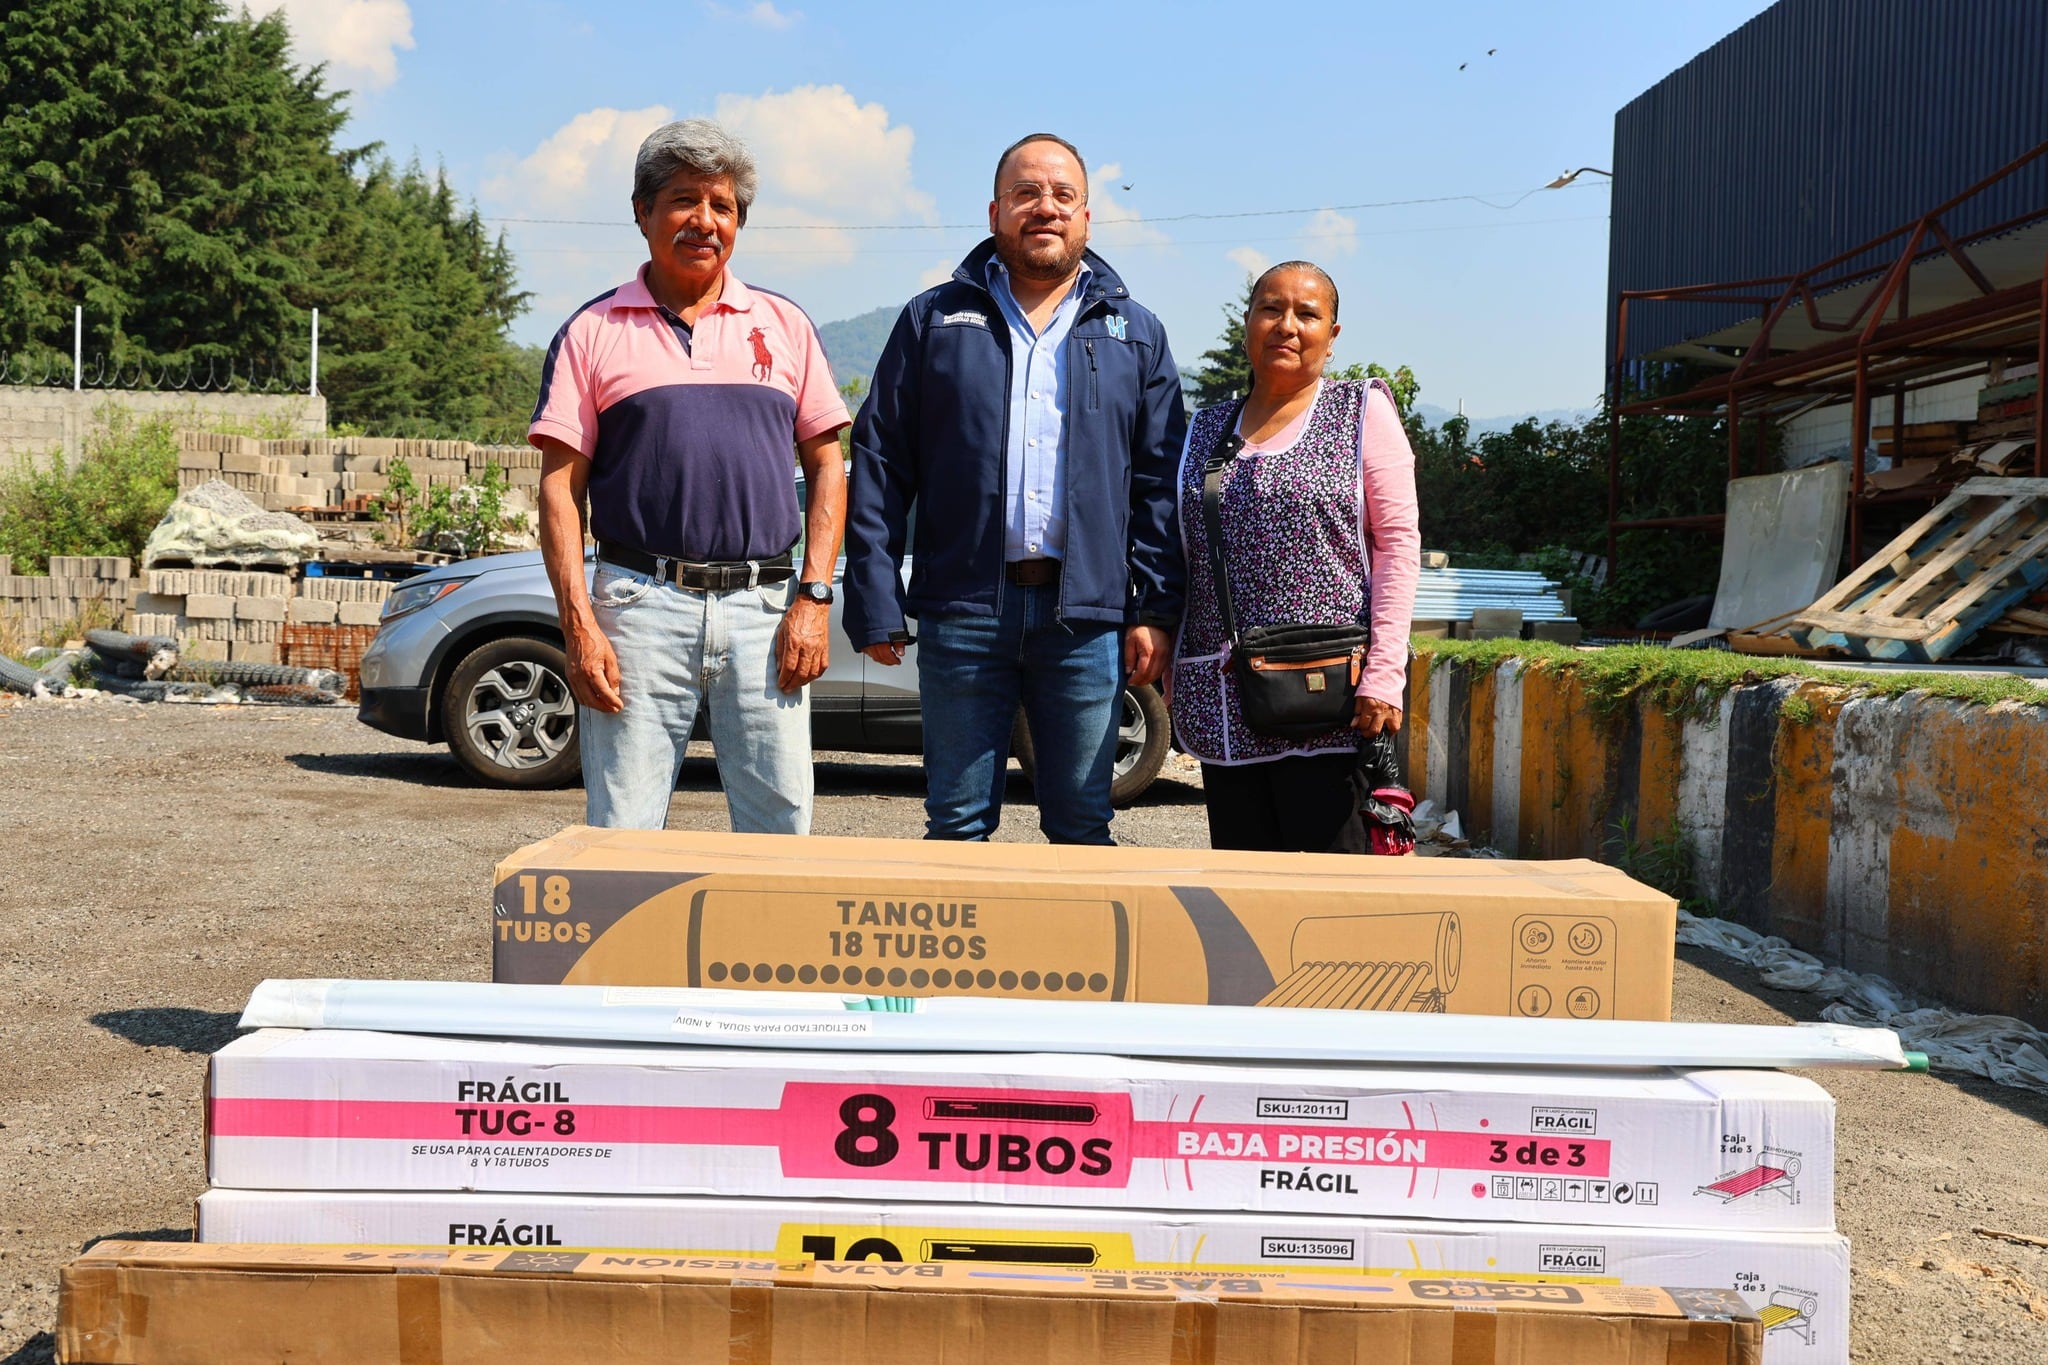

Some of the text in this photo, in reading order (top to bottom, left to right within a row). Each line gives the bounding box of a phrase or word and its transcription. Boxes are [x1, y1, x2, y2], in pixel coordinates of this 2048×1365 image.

[518, 874, 572, 915] 18
[836, 900, 978, 930] TANQUE
[497, 919, 592, 944] TUBOS
[828, 931, 987, 961] 18 TUBOS
[704, 1020, 712, 1029] A
[717, 1021, 751, 1033] SDUAL
[753, 1024, 781, 1033] PARA
[783, 1023, 849, 1033] ETIQUETADO
[851, 1023, 867, 1033] NO
[457, 1075, 570, 1104] FRÁGIL
[1263, 1103, 1341, 1116] SKU:120111
[1535, 1113, 1593, 1128] FRÁGIL
[834, 1093, 1113, 1177] 8 TUBOS
[1722, 1134, 1746, 1145] Caja
[411, 1145, 613, 1159] SE USA PARA CALENTADORES DE
[1176, 1131, 1426, 1164] BAJA PRESIÓN
[1488, 1140, 1586, 1167] 3 de 3
[1720, 1144, 1752, 1153] 3 de 3
[470, 1158, 479, 1168] 8
[483, 1158, 492, 1168] Y
[1259, 1166, 1359, 1195] FRÁGIL
[448, 1218, 562, 1247] FRÁGIL
[1267, 1242, 1349, 1256] SKU:135096
[601, 1255, 807, 1273] PRESIÓN
[1543, 1251, 1601, 1266] FRÁGIL
[823, 1263, 944, 1278] BAJA
[1735, 1272, 1760, 1283] Caja
[1091, 1274, 1264, 1293] BASE
[1733, 1283, 1766, 1292] 3 de 3
